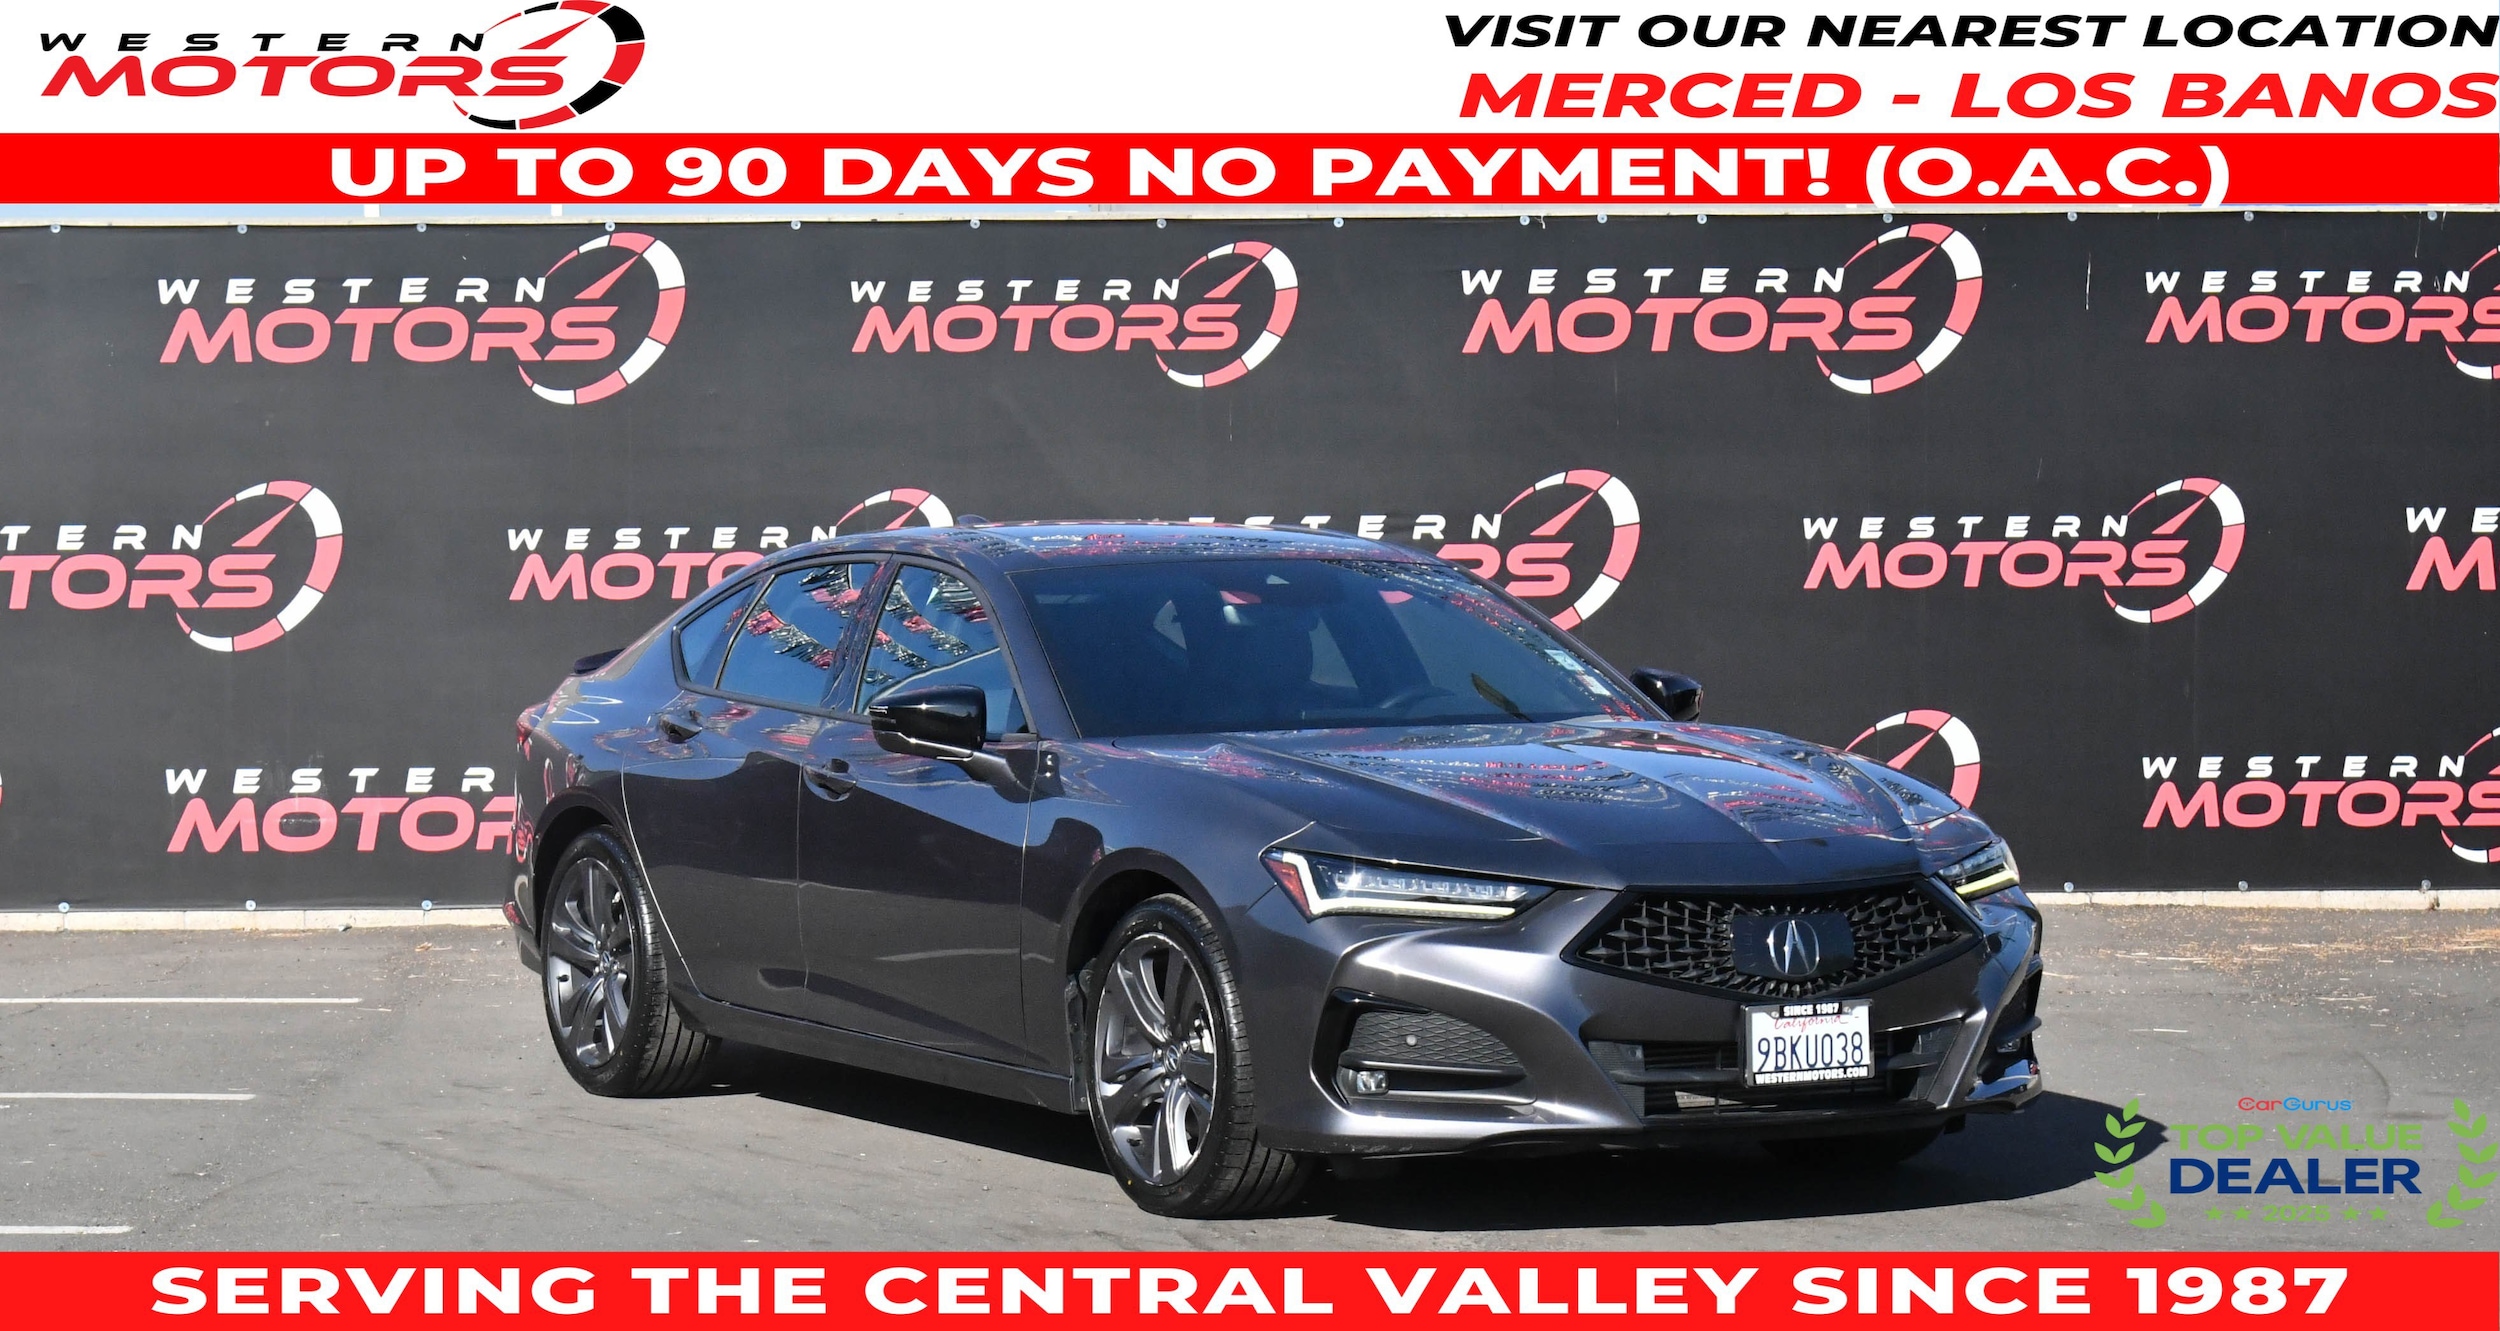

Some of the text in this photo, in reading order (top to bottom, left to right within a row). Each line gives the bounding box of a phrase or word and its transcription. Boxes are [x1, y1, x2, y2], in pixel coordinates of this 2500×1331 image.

[158, 278, 547, 304] WESTERN
[851, 279, 1180, 303] WESTERN
[1462, 268, 1844, 296] WESTERN
[2146, 271, 2469, 293] WESTERN
[161, 307, 618, 364] MOTORS
[853, 305, 1241, 353] MOTORS
[1463, 297, 1916, 354] MOTORS
[0, 524, 203, 551] TERN
[1803, 515, 2128, 540] WESTERN
[1804, 540, 2188, 589] MOTORS
[0, 554, 275, 610] TORS
[166, 767, 495, 794] WESTER
[2143, 756, 2466, 778] WESTERN
[1775, 1015, 1848, 1031] California
[1783, 1003, 1839, 1017] SINCE 1987
[1757, 1031, 1863, 1072] 9BKU038
[1755, 1066, 1868, 1085] WESTERNMOTORS.COM
